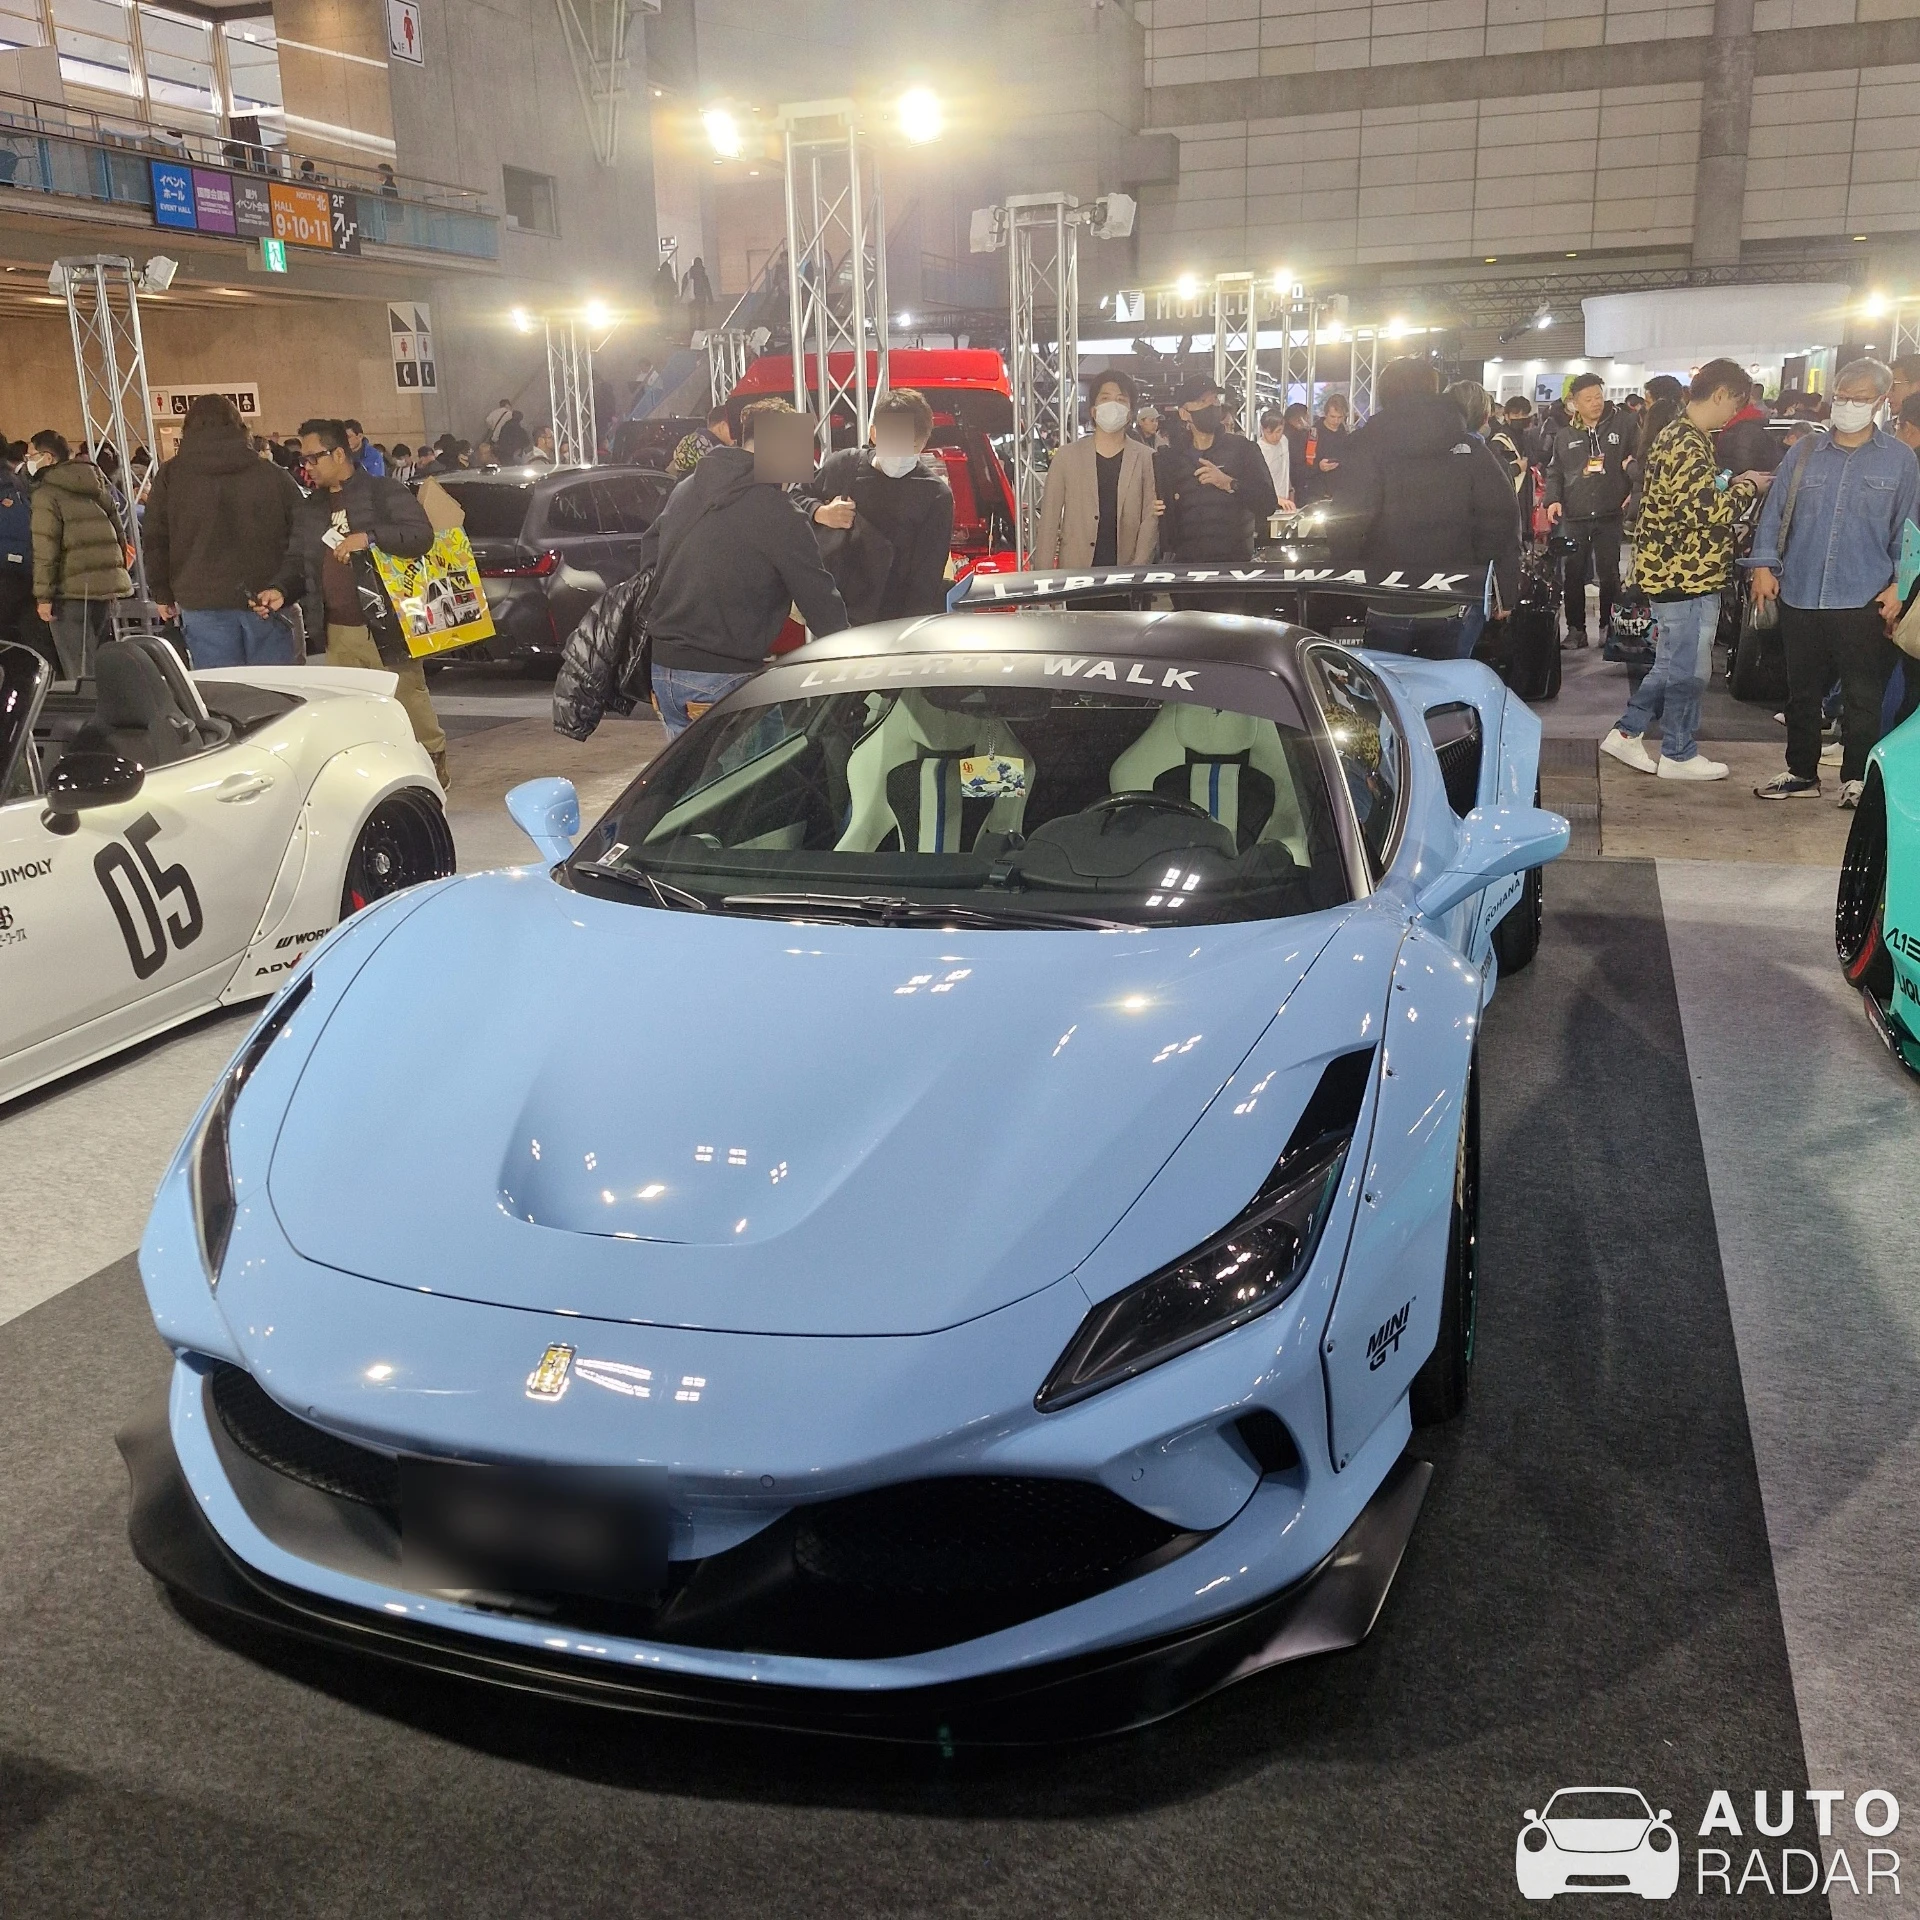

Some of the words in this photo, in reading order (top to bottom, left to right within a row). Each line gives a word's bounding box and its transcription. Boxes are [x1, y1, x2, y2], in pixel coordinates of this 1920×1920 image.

[160, 175, 186, 189] イベント
[163, 188, 186, 201] ホール
[296, 191, 316, 201] NORTH
[332, 194, 345, 208] 2F
[160, 203, 177, 212] EVENT
[178, 205, 192, 214] HALL
[274, 201, 294, 213] HALL
[317, 195, 326, 211] 北
[993, 570, 1266, 599] LIBERTY
[1283, 569, 1470, 592] WALK
[1043, 658, 1201, 693] WALK
[94, 811, 204, 980] 05
[1485, 878, 1521, 927] ROHANA
[1366, 1300, 1411, 1359] MINI
[1369, 1324, 1407, 1371] GT
